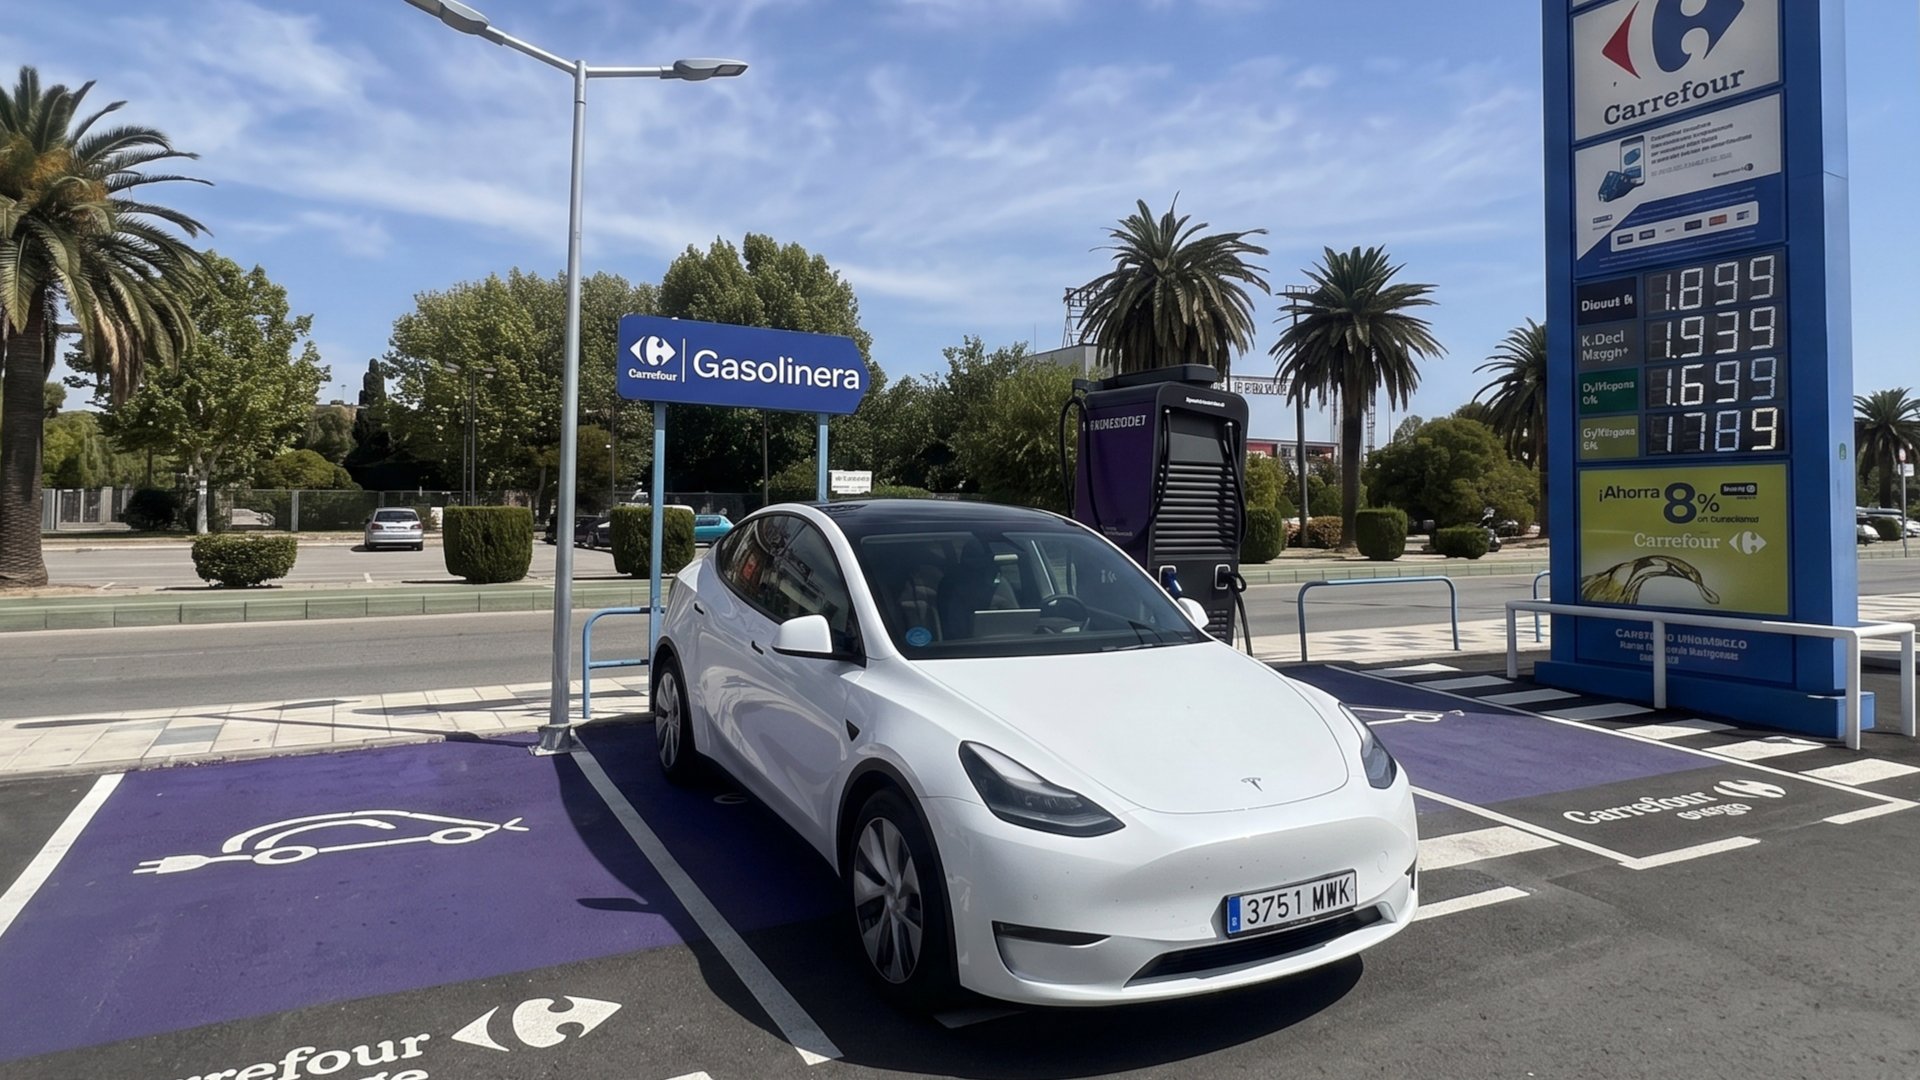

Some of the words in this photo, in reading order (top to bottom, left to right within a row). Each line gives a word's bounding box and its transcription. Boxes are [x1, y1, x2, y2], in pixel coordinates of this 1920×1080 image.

[1604, 69, 1745, 125] Carrefour
[1665, 255, 1775, 312] 1.899
[1665, 306, 1775, 358] 1.939
[628, 368, 677, 382] Carrefour
[693, 349, 860, 390] Gasolinera
[1665, 357, 1777, 406] 1.699
[1599, 485, 1660, 502] ¡Ahorra
[1634, 532, 1721, 549] Carrefour
[1562, 791, 1718, 825] Carrefour
[1246, 890, 1301, 925] 3751
[1313, 876, 1350, 912] MWK
